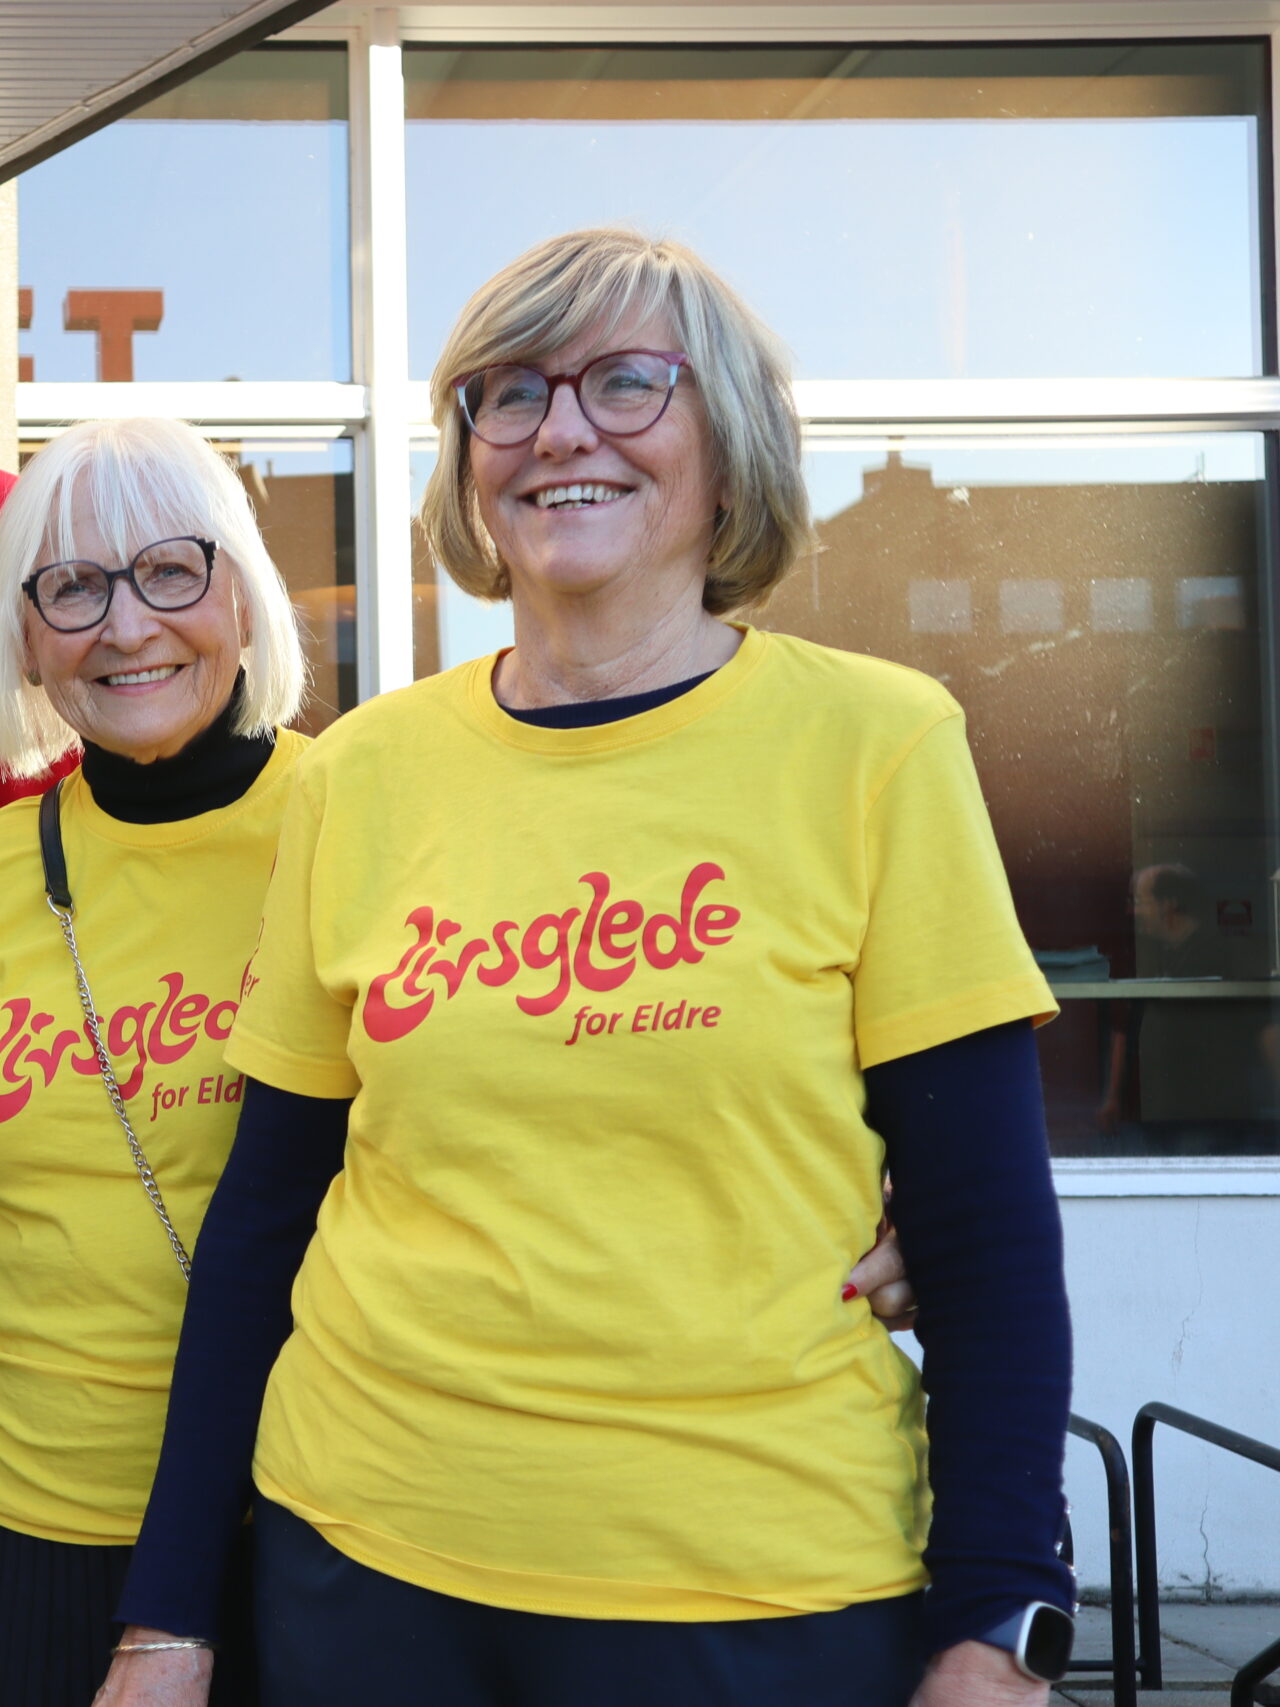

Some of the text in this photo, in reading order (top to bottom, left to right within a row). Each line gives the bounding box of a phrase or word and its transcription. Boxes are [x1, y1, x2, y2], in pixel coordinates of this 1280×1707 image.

[362, 861, 741, 1043] Livsglede
[565, 999, 721, 1046] for Eldre
[150, 1073, 245, 1121] for Eld
